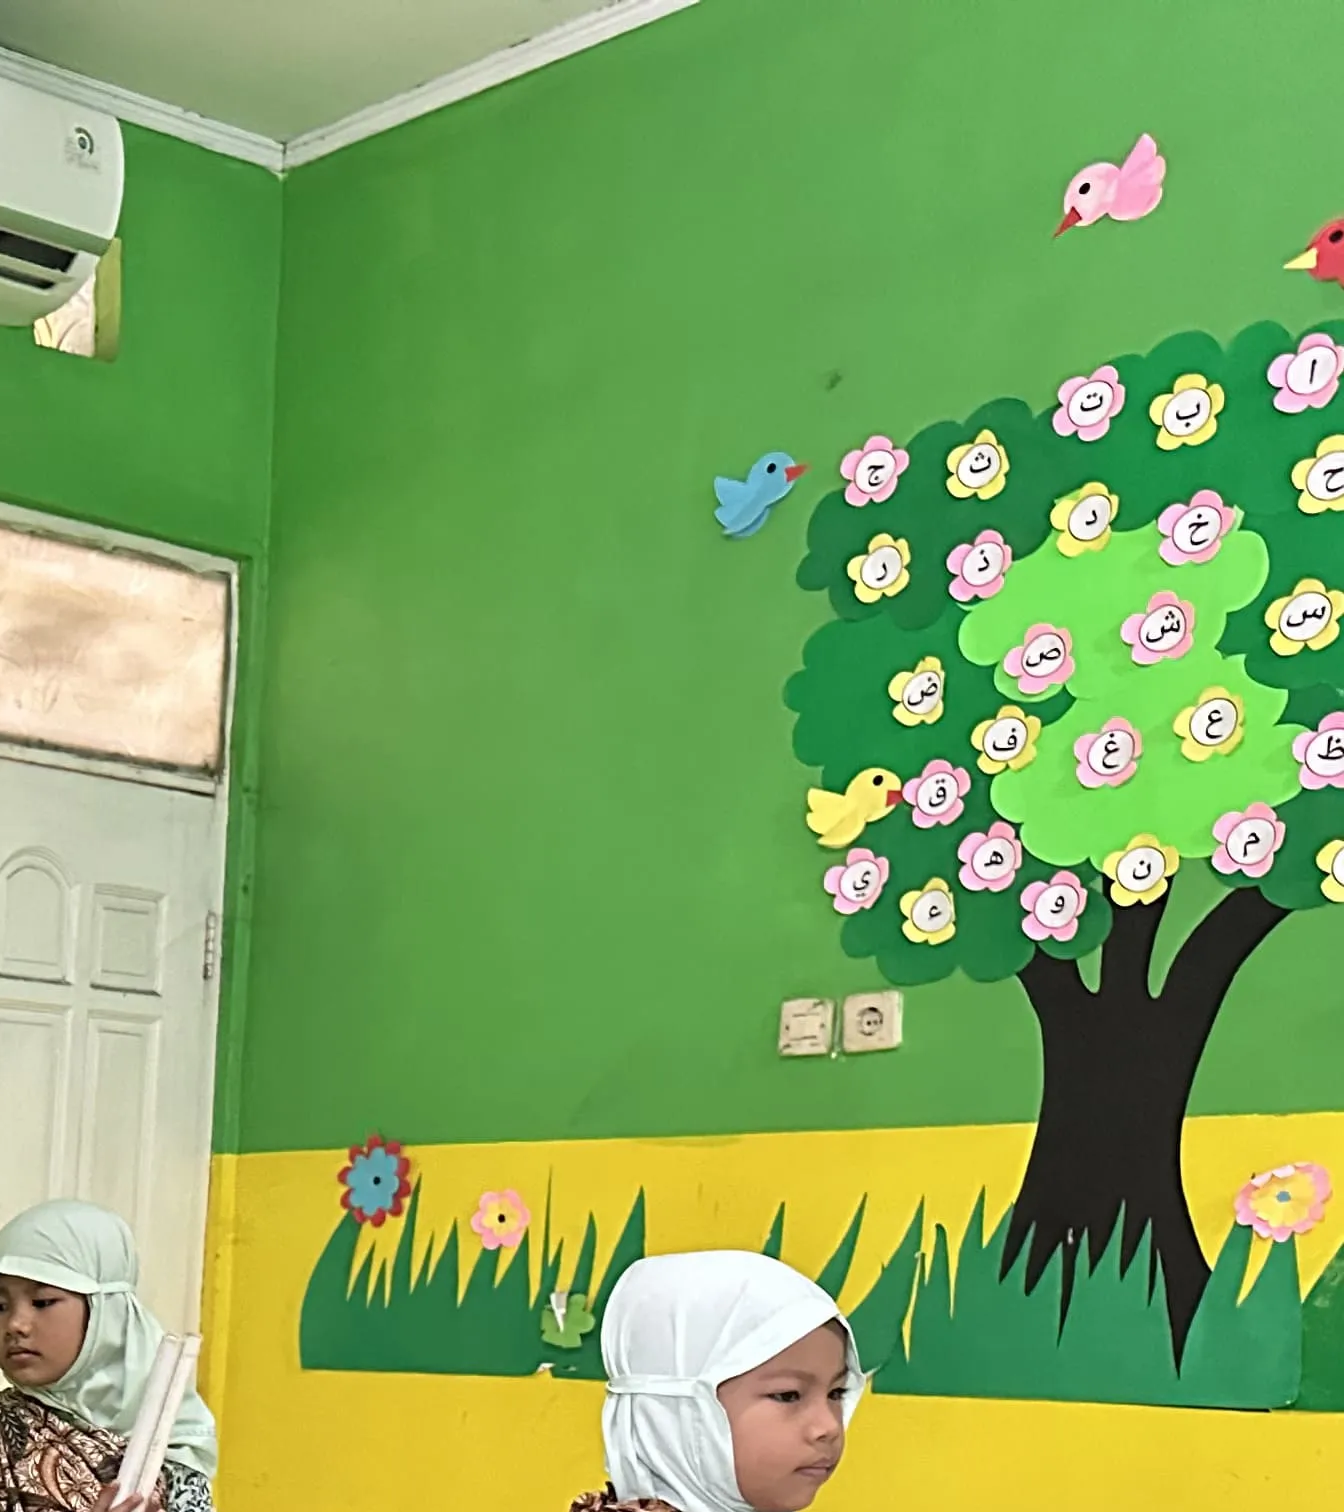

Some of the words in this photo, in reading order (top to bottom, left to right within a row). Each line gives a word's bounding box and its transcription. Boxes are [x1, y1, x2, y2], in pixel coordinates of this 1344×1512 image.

[1079, 392, 1104, 412] ت
[1175, 403, 1201, 428] ب
[969, 452, 992, 474] ث
[867, 464, 885, 487] ج
[1085, 509, 1098, 526] د
[1188, 513, 1209, 546] خ
[876, 563, 888, 582] ر
[977, 549, 990, 572] ذ
[1144, 609, 1182, 644] ش
[1285, 603, 1327, 627] س
[1025, 647, 1062, 668] ص
[907, 677, 938, 707] ض
[1205, 709, 1223, 740] ع
[992, 727, 1018, 752] ف
[1102, 732, 1120, 769] غ
[928, 778, 947, 808] ق
[1243, 832, 1260, 857] م
[1132, 860, 1152, 881] ن
[852, 869, 872, 897] ي
[1050, 895, 1065, 914] و
